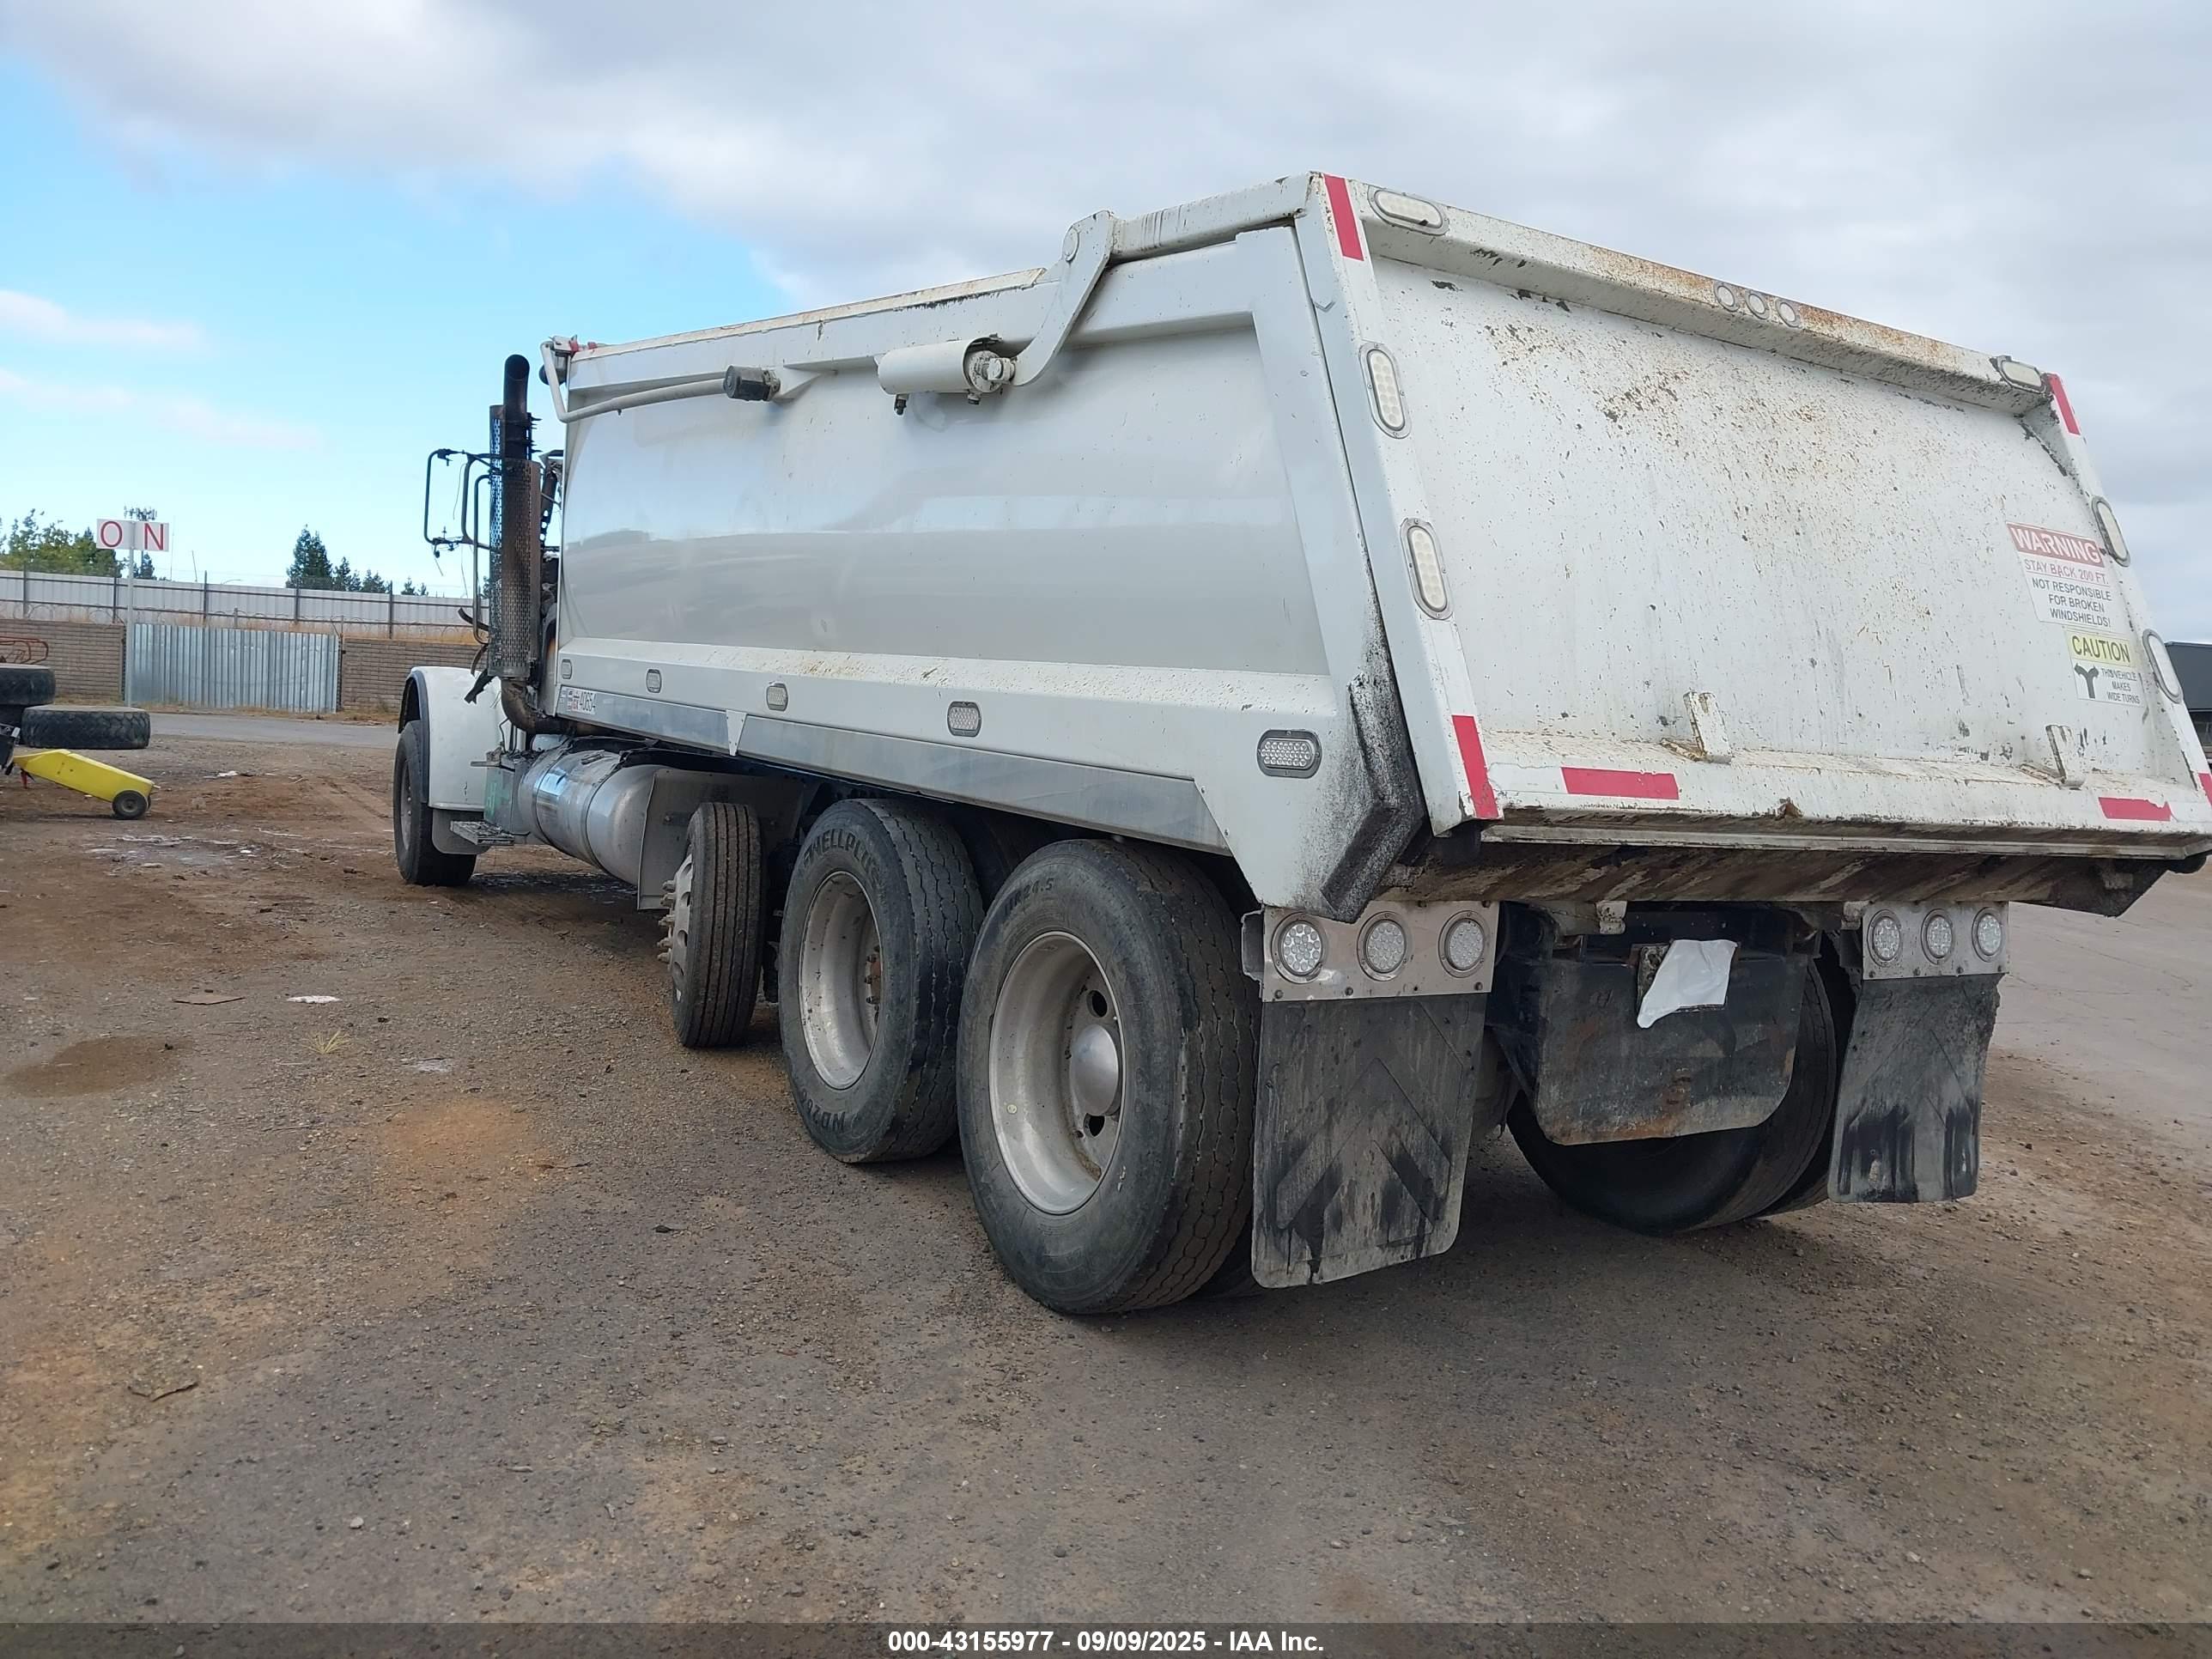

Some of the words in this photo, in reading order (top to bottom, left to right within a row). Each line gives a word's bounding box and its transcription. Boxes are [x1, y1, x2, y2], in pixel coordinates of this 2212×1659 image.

[2010, 527, 2100, 563] WARNING
[2024, 559, 2047, 573] STAY
[2050, 563, 2075, 578] BACK
[2078, 569, 2094, 581] 200
[2095, 572, 2109, 585] FT.
[2032, 577, 2051, 590] NOT
[2053, 581, 2112, 601] RESPONSIBLE
[2049, 593, 2067, 606] FOR
[2069, 596, 2105, 612] BROKEN
[2050, 608, 2111, 627] WINDSHIELDS!
[2072, 635, 2131, 663] CAUTION
[2112, 680, 2131, 691] MAKES
[2107, 691, 2121, 702] WIDE
[2122, 693, 2140, 704] TURNS
